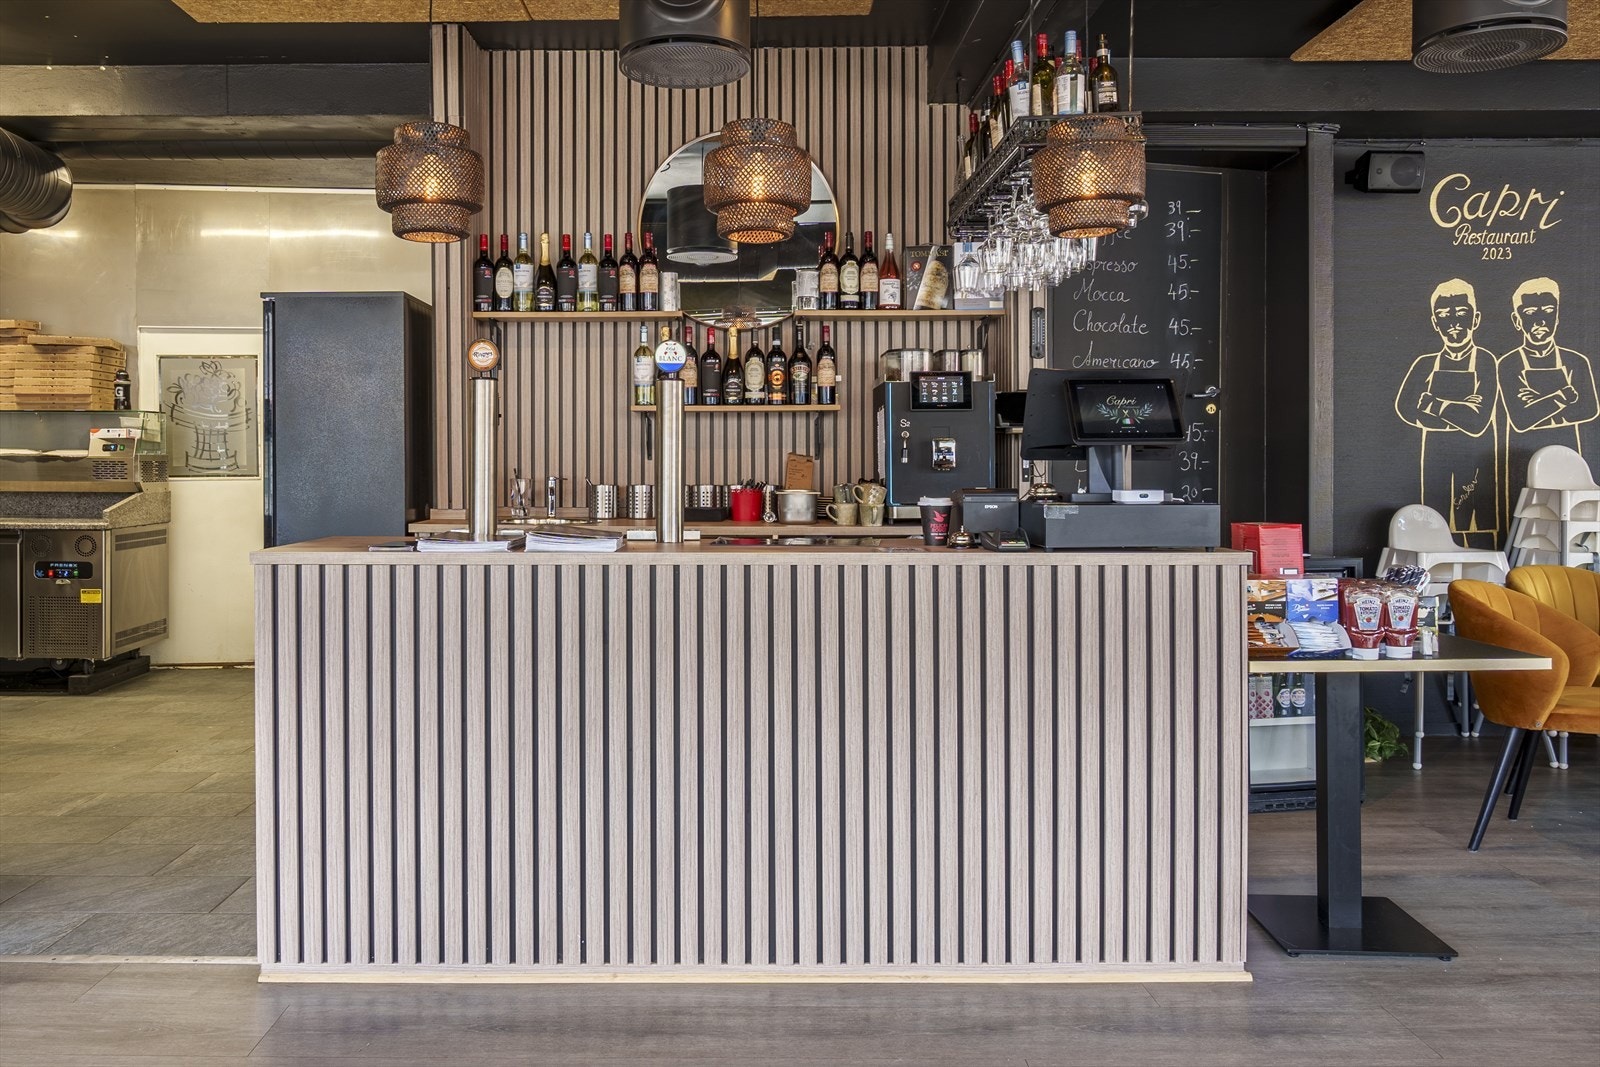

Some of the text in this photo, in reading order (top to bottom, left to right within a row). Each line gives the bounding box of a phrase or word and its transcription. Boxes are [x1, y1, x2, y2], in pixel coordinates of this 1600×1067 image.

[1429, 173, 1565, 230] Capri
[1452, 223, 1537, 246] Restaurant
[1481, 247, 1513, 260] 2023
[1083, 254, 1200, 276] spresso 45.-
[1073, 278, 1200, 303] Mocca 45.-
[1073, 309, 1203, 336] Chocolate 45.-
[1072, 340, 1160, 369] Americano
[115, 386, 124, 397] G
[1106, 394, 1137, 409] Capri
[1178, 450, 1211, 471] 39.-
